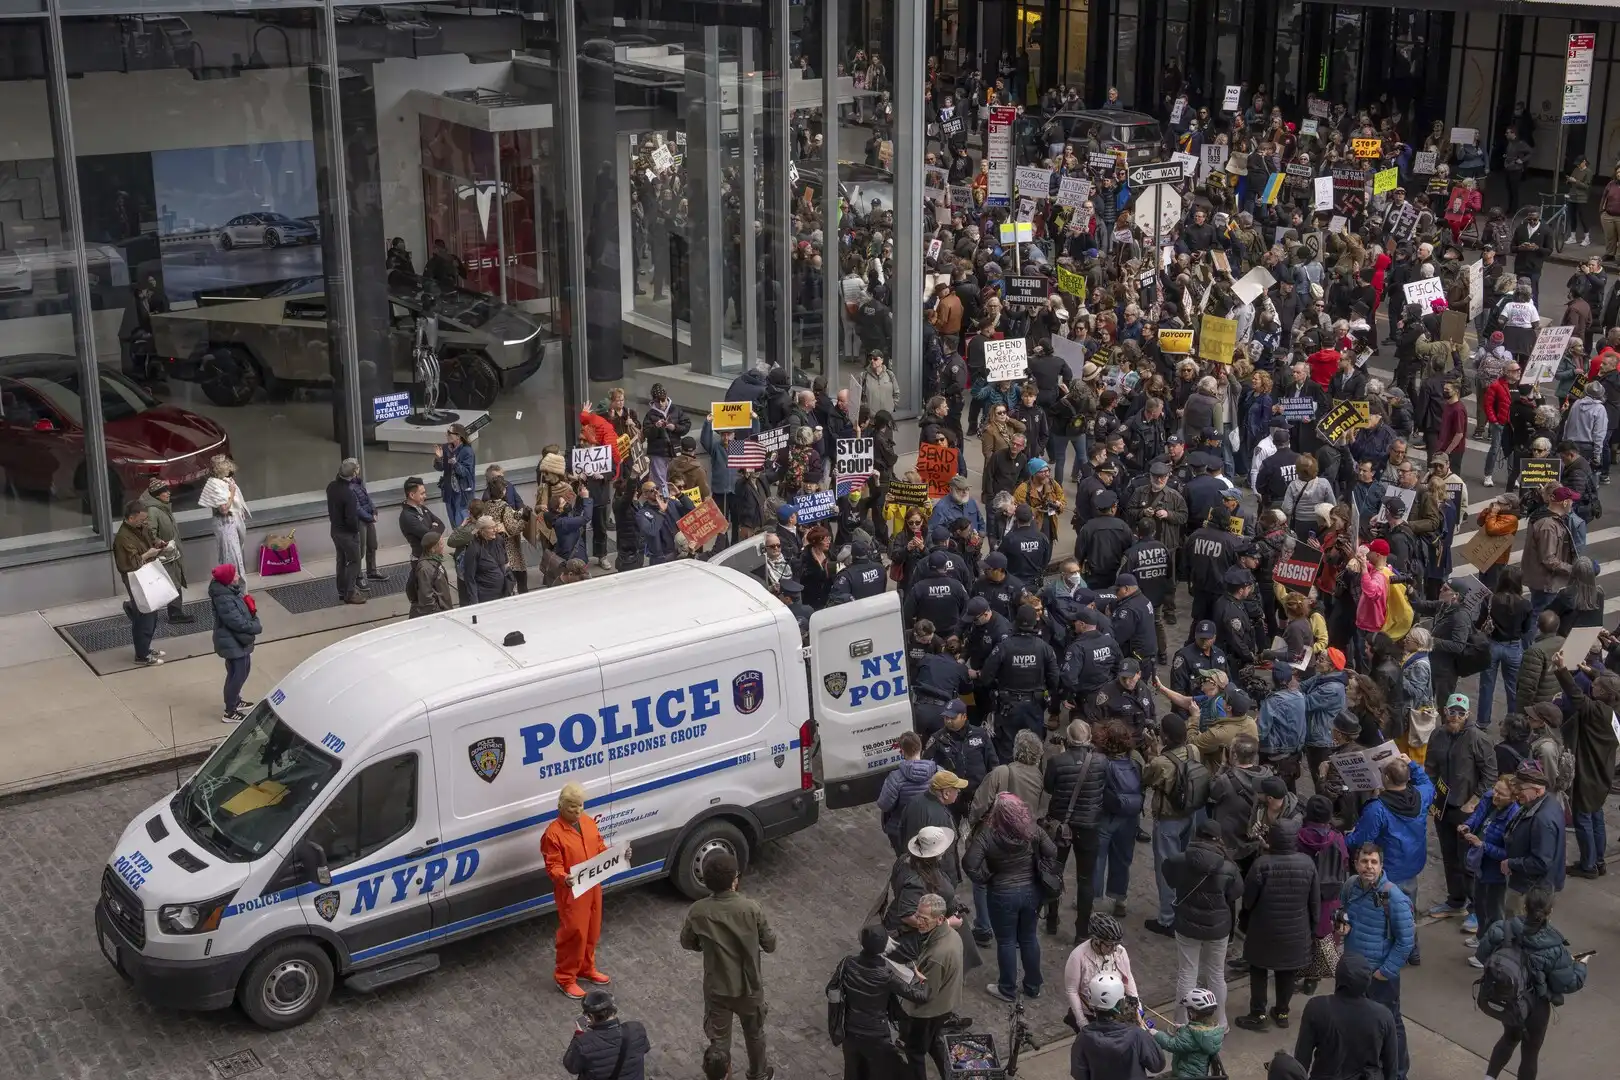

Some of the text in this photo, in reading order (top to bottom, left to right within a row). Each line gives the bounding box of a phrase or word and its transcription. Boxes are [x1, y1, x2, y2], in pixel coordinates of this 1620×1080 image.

[1021, 171, 1043, 180] GLOBAL
[1136, 168, 1178, 180] ONE WAY
[1016, 179, 1049, 192] DISGRACE
[462, 256, 518, 270] ESLA
[1140, 268, 1155, 280] BOYCOTT
[1012, 278, 1040, 288] DEFEND
[1142, 276, 1153, 287] TESLA
[987, 341, 1022, 352] DEFEND
[987, 355, 1025, 364] AMERICAN
[374, 393, 409, 404] BILLIONAIRES
[376, 405, 409, 415] STEALING
[1323, 404, 1349, 430] WTF?
[1329, 414, 1359, 441] MUSK
[758, 432, 768, 440] THIS
[775, 428, 784, 437] THE
[779, 441, 787, 449] JOB
[837, 439, 873, 455] STOP
[574, 446, 609, 462] NAZI
[919, 445, 955, 463] SEND
[575, 462, 608, 475] SCUM
[837, 458, 873, 474] COUP
[916, 462, 950, 472] ELON
[814, 490, 833, 499] WILL
[692, 520, 717, 541] MUSK
[1194, 538, 1222, 557] NYPD
[1138, 548, 1166, 560] NYPD
[862, 569, 878, 580] NYPD
[1140, 569, 1166, 579] LEGAL
[1277, 562, 1315, 582] FASCIST
[929, 586, 950, 594] NYPD
[1093, 647, 1111, 657] NYPD
[861, 651, 904, 679] NY
[1013, 655, 1036, 663] NYPD
[736, 672, 760, 686] POLICE
[849, 676, 907, 707] POL
[520, 679, 720, 766] POLICE
[321, 732, 346, 753] NYPD
[477, 739, 495, 747] POLICE
[863, 741, 884, 751] $10,000
[539, 724, 707, 779] STRATEGIC RESPONSE GROUP
[771, 744, 785, 755] 1959
[739, 753, 751, 764] SRG
[868, 758, 888, 768] KEEP
[1337, 757, 1364, 766] UGLIER
[594, 808, 635, 824] COURTESY
[129, 851, 153, 874] NYPD
[114, 856, 146, 891] POLICE
[577, 855, 620, 884] FELON
[350, 848, 479, 916] NYPD
[237, 892, 281, 914] POLICE
